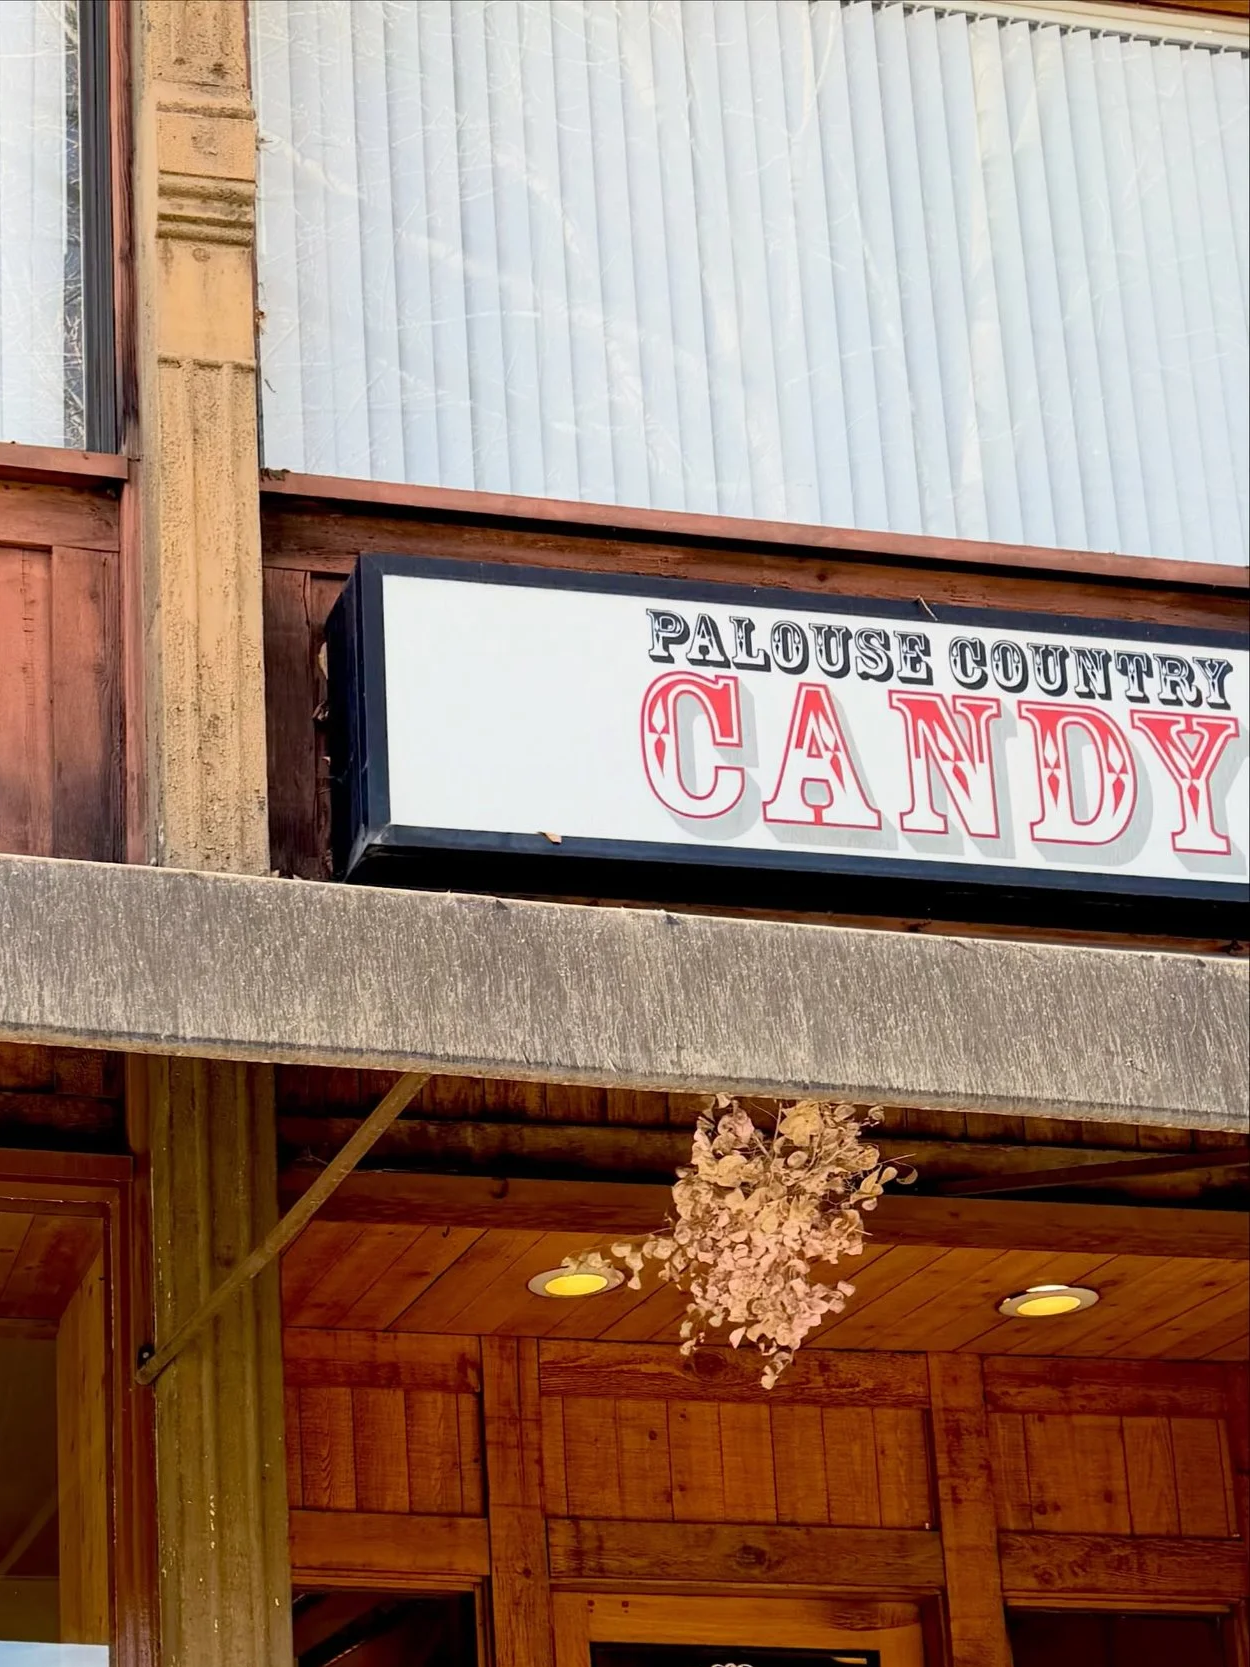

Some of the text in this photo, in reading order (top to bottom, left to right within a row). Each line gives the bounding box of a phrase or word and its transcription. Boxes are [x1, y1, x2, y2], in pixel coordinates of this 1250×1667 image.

[646, 607, 1235, 711] PALOUSE COUNTRY
[641, 670, 1242, 858] CANDY
